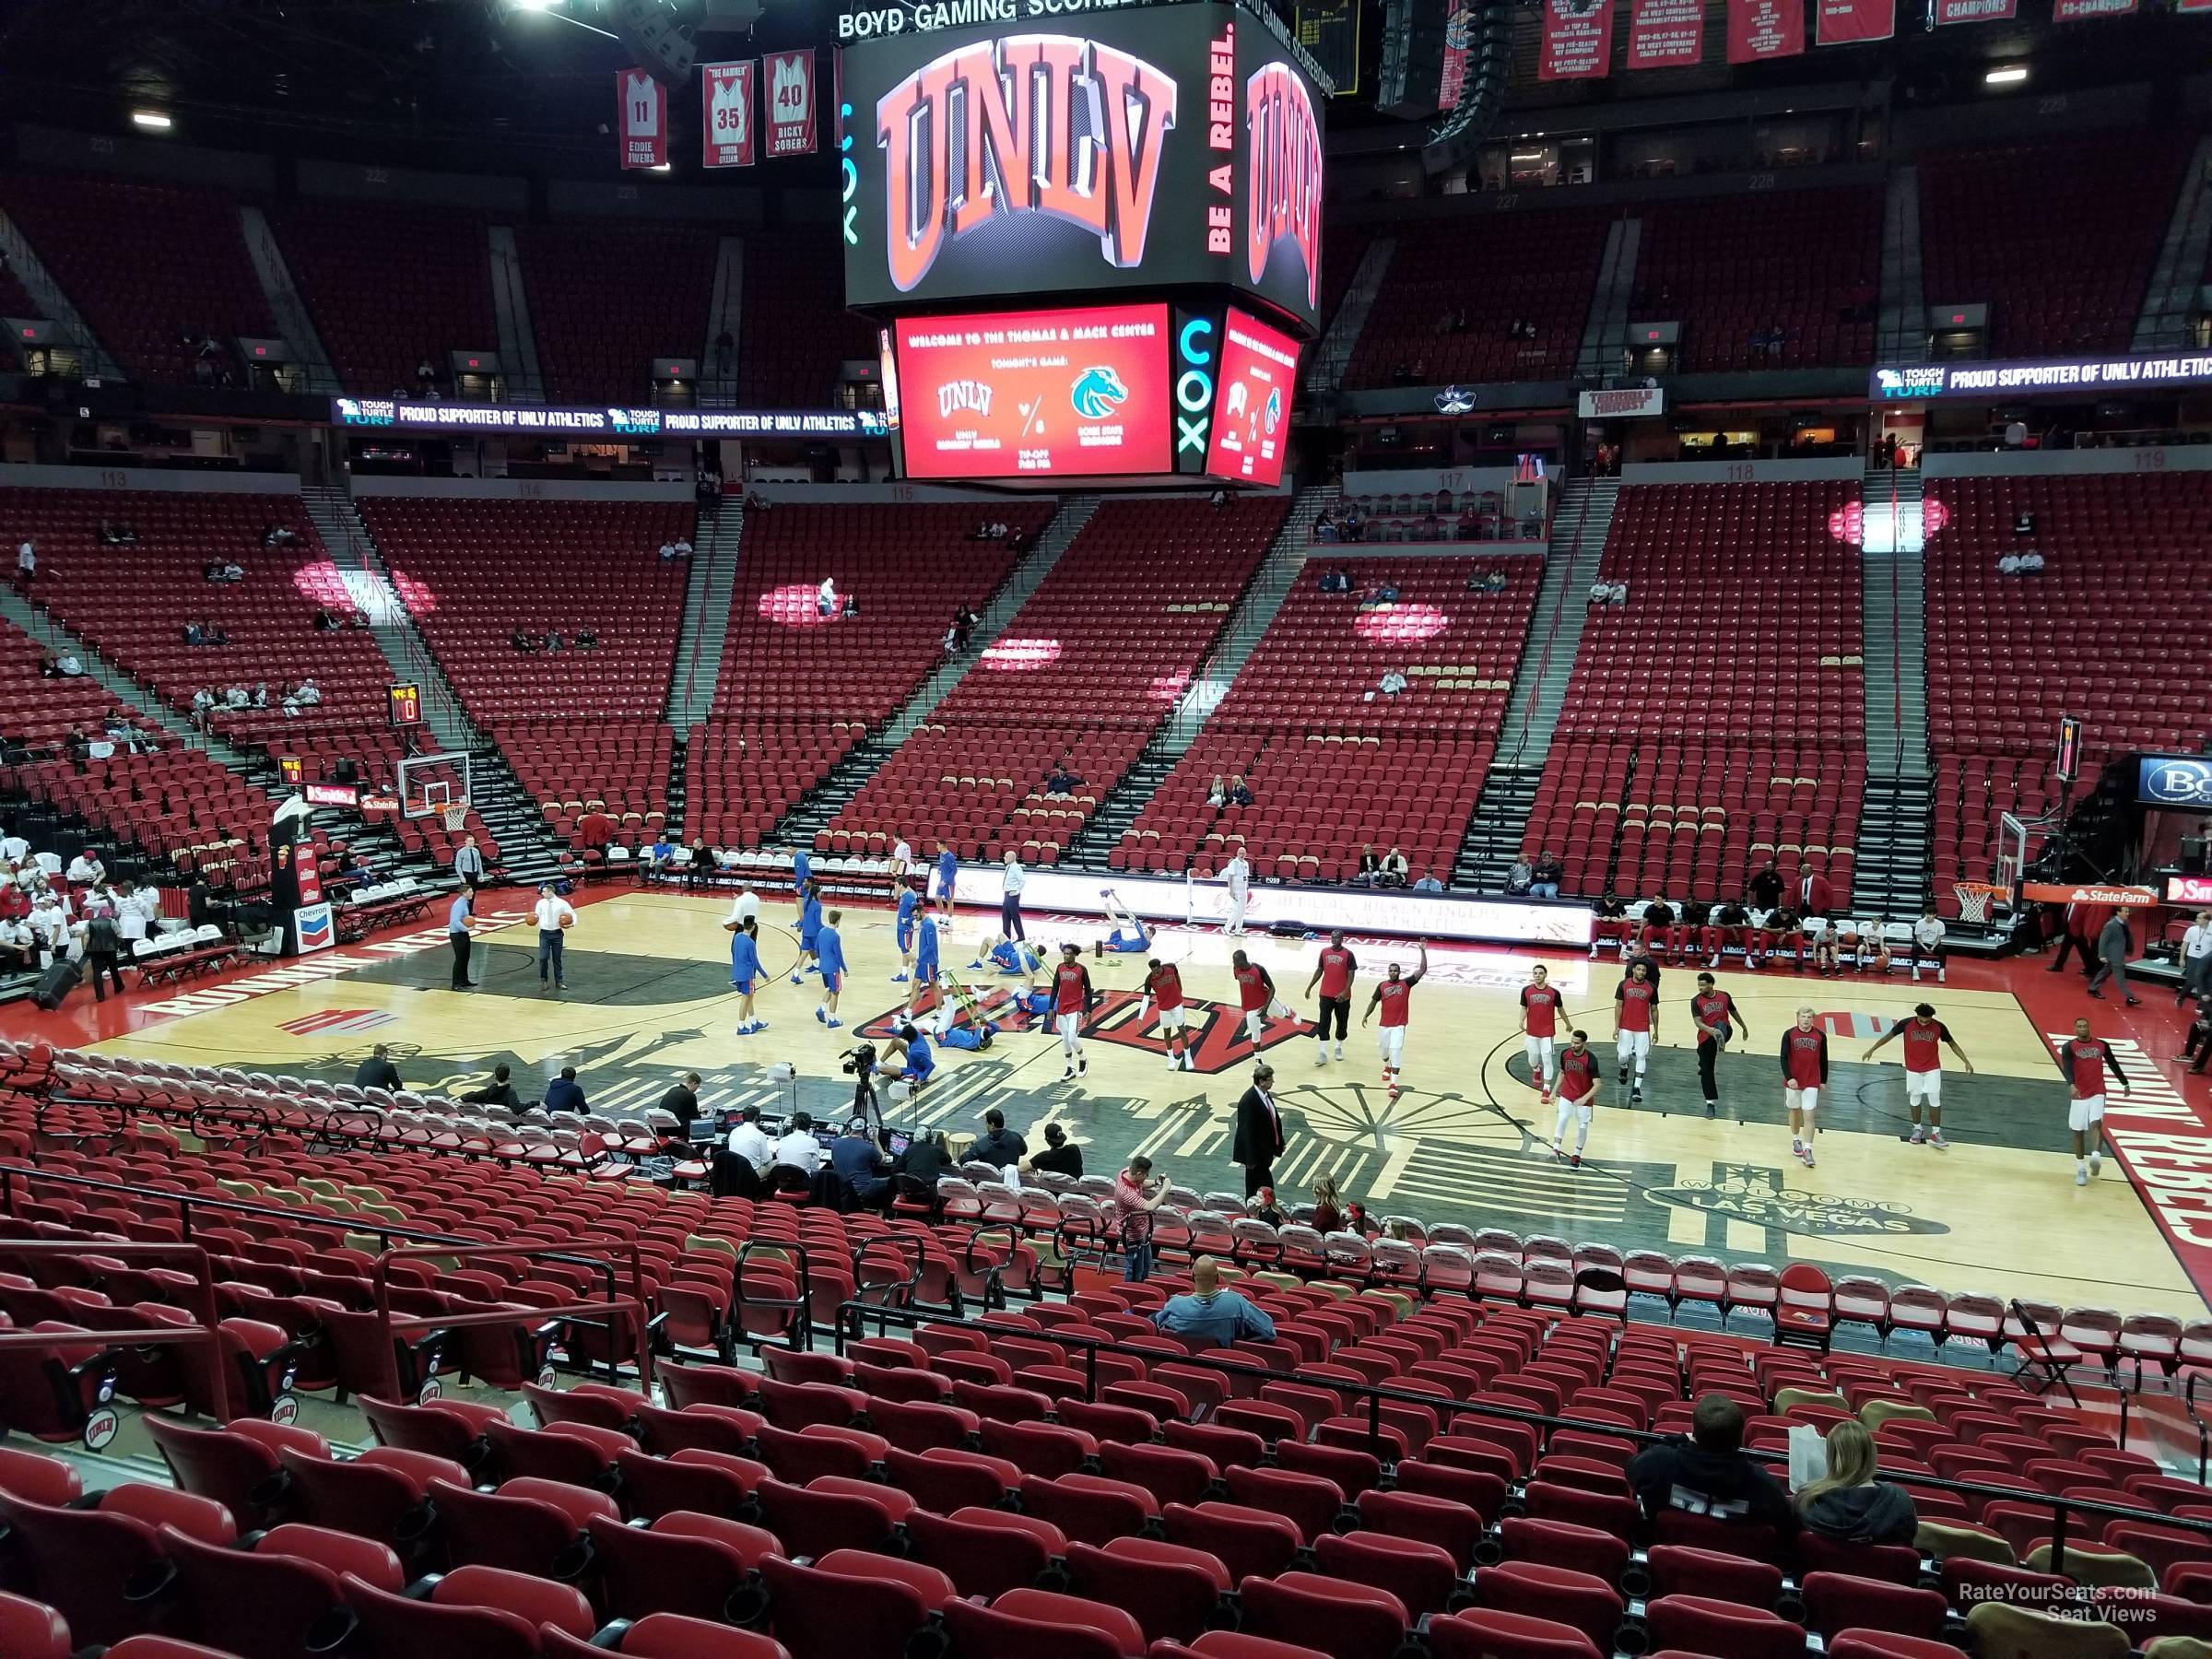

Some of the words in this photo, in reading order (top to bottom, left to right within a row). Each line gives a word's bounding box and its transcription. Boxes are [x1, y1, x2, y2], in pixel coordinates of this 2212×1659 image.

[1947, 0, 2006, 17] CHAMPIONS
[839, 8, 903, 37] BOYD
[915, 0, 1017, 29] GAMING
[1263, 5, 1290, 49] GAMING
[1291, 38, 1335, 98] SCOREBOARD
[1209, 22, 1235, 150] REBEL.
[778, 84, 802, 107] 40
[634, 101, 648, 122] 11
[717, 108, 739, 130] 35
[778, 125, 803, 138] RICKY
[629, 142, 653, 152] EDDIE
[775, 138, 807, 151] SOBERS
[877, 33, 1178, 292] UNLV
[1209, 165, 1231, 195] A
[1496, 194, 1518, 208] 227
[1209, 206, 1231, 253] BE
[909, 333, 962, 348] WELCOME
[966, 333, 981, 346] TO
[983, 331, 1004, 344] THE
[1006, 328, 1056, 344] THOMAS
[1073, 326, 1108, 339] MACK
[1111, 324, 1155, 337] CENTER
[1906, 368, 1945, 379] TOUGH
[1950, 371, 1996, 389] PROUD
[1999, 365, 2079, 386] SUPPORTER
[2081, 365, 2101, 382] OF
[2102, 362, 2141, 381] UNLV
[1177, 320, 1211, 454] COX
[1906, 377, 1943, 387] TURTLE
[1882, 385, 1942, 397] TURF
[361, 400, 394, 409] TOUGH
[937, 381, 993, 418] UNLV
[343, 415, 394, 426] TURF
[361, 408, 394, 417] TURTLE
[400, 406, 436, 422] PROUD
[438, 407, 501, 424] SUPPORTER
[502, 409, 516, 425] OF
[518, 411, 546, 426] UNLV
[547, 411, 605, 428] ATHLETICS
[615, 425, 659, 434] TURF
[630, 418, 659, 426] TURTLE
[665, 415, 699, 429] PROUD
[701, 415, 759, 430] SUPPORTER
[761, 415, 773, 430] OF
[776, 416, 801, 430] UNLV
[803, 416, 855, 430] ATHLETICS
[2135, 451, 2164, 468] 119
[101, 471, 126, 487] 113
[1439, 472, 1463, 488] 117
[1727, 465, 1753, 480] 118
[883, 487, 904, 501] 115
[406, 700, 415, 719] 0
[2089, 890, 2150, 903] StateFarm
[299, 906, 327, 918] Chevron
[1684, 1180, 1910, 1212] WELCOME
[1692, 1196, 1767, 1215] LAS
[1777, 1206, 1911, 1232] VEGAS
[1747, 1214, 1846, 1230] NEVADA
